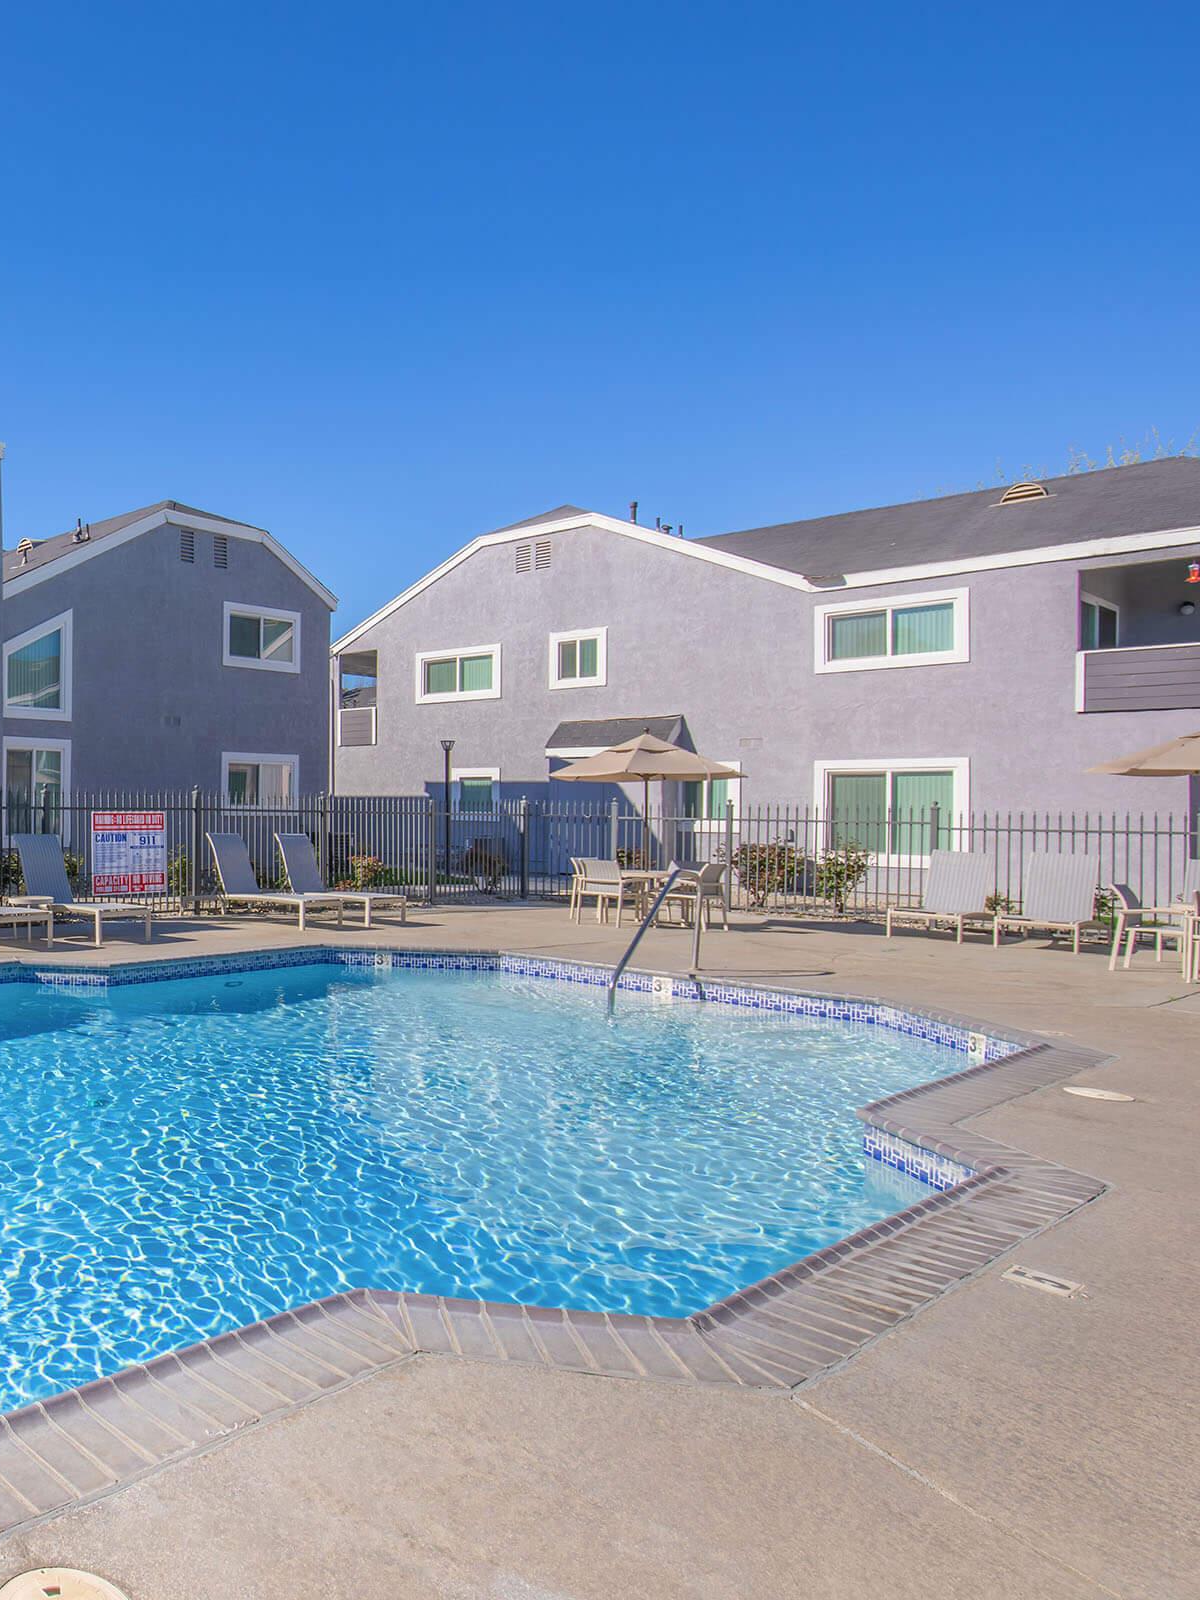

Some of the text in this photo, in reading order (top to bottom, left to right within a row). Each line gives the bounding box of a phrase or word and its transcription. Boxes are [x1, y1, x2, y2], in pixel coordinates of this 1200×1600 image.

[95, 832, 127, 843] CAUTION
[139, 836, 156, 845] 911
[95, 875, 128, 886] CAPACITY
